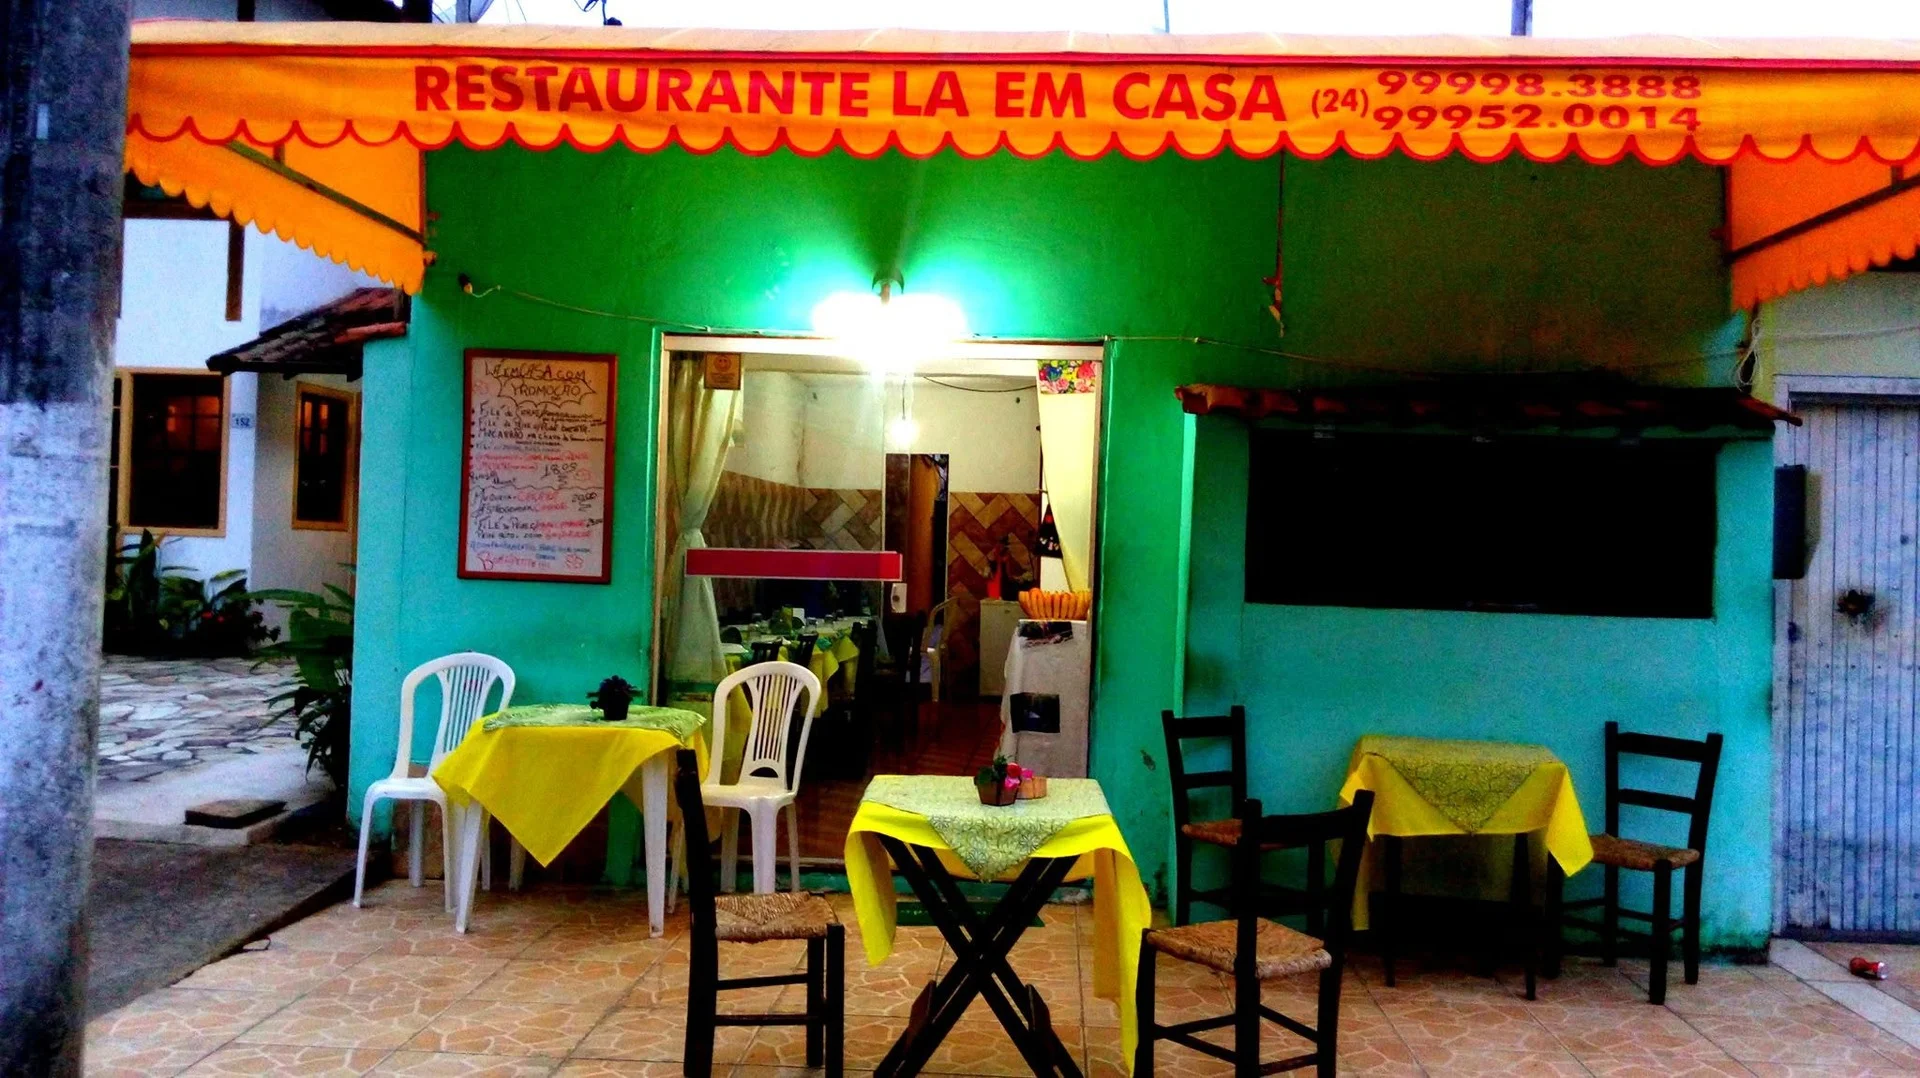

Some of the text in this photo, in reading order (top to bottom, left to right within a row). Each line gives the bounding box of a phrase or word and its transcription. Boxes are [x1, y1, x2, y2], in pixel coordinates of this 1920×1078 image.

[415, 65, 1369, 121] RESTAURANTE LA EM CASA (24)
[1377, 70, 1702, 101] 99998.3888
[1373, 104, 1700, 133] 99952.0014
